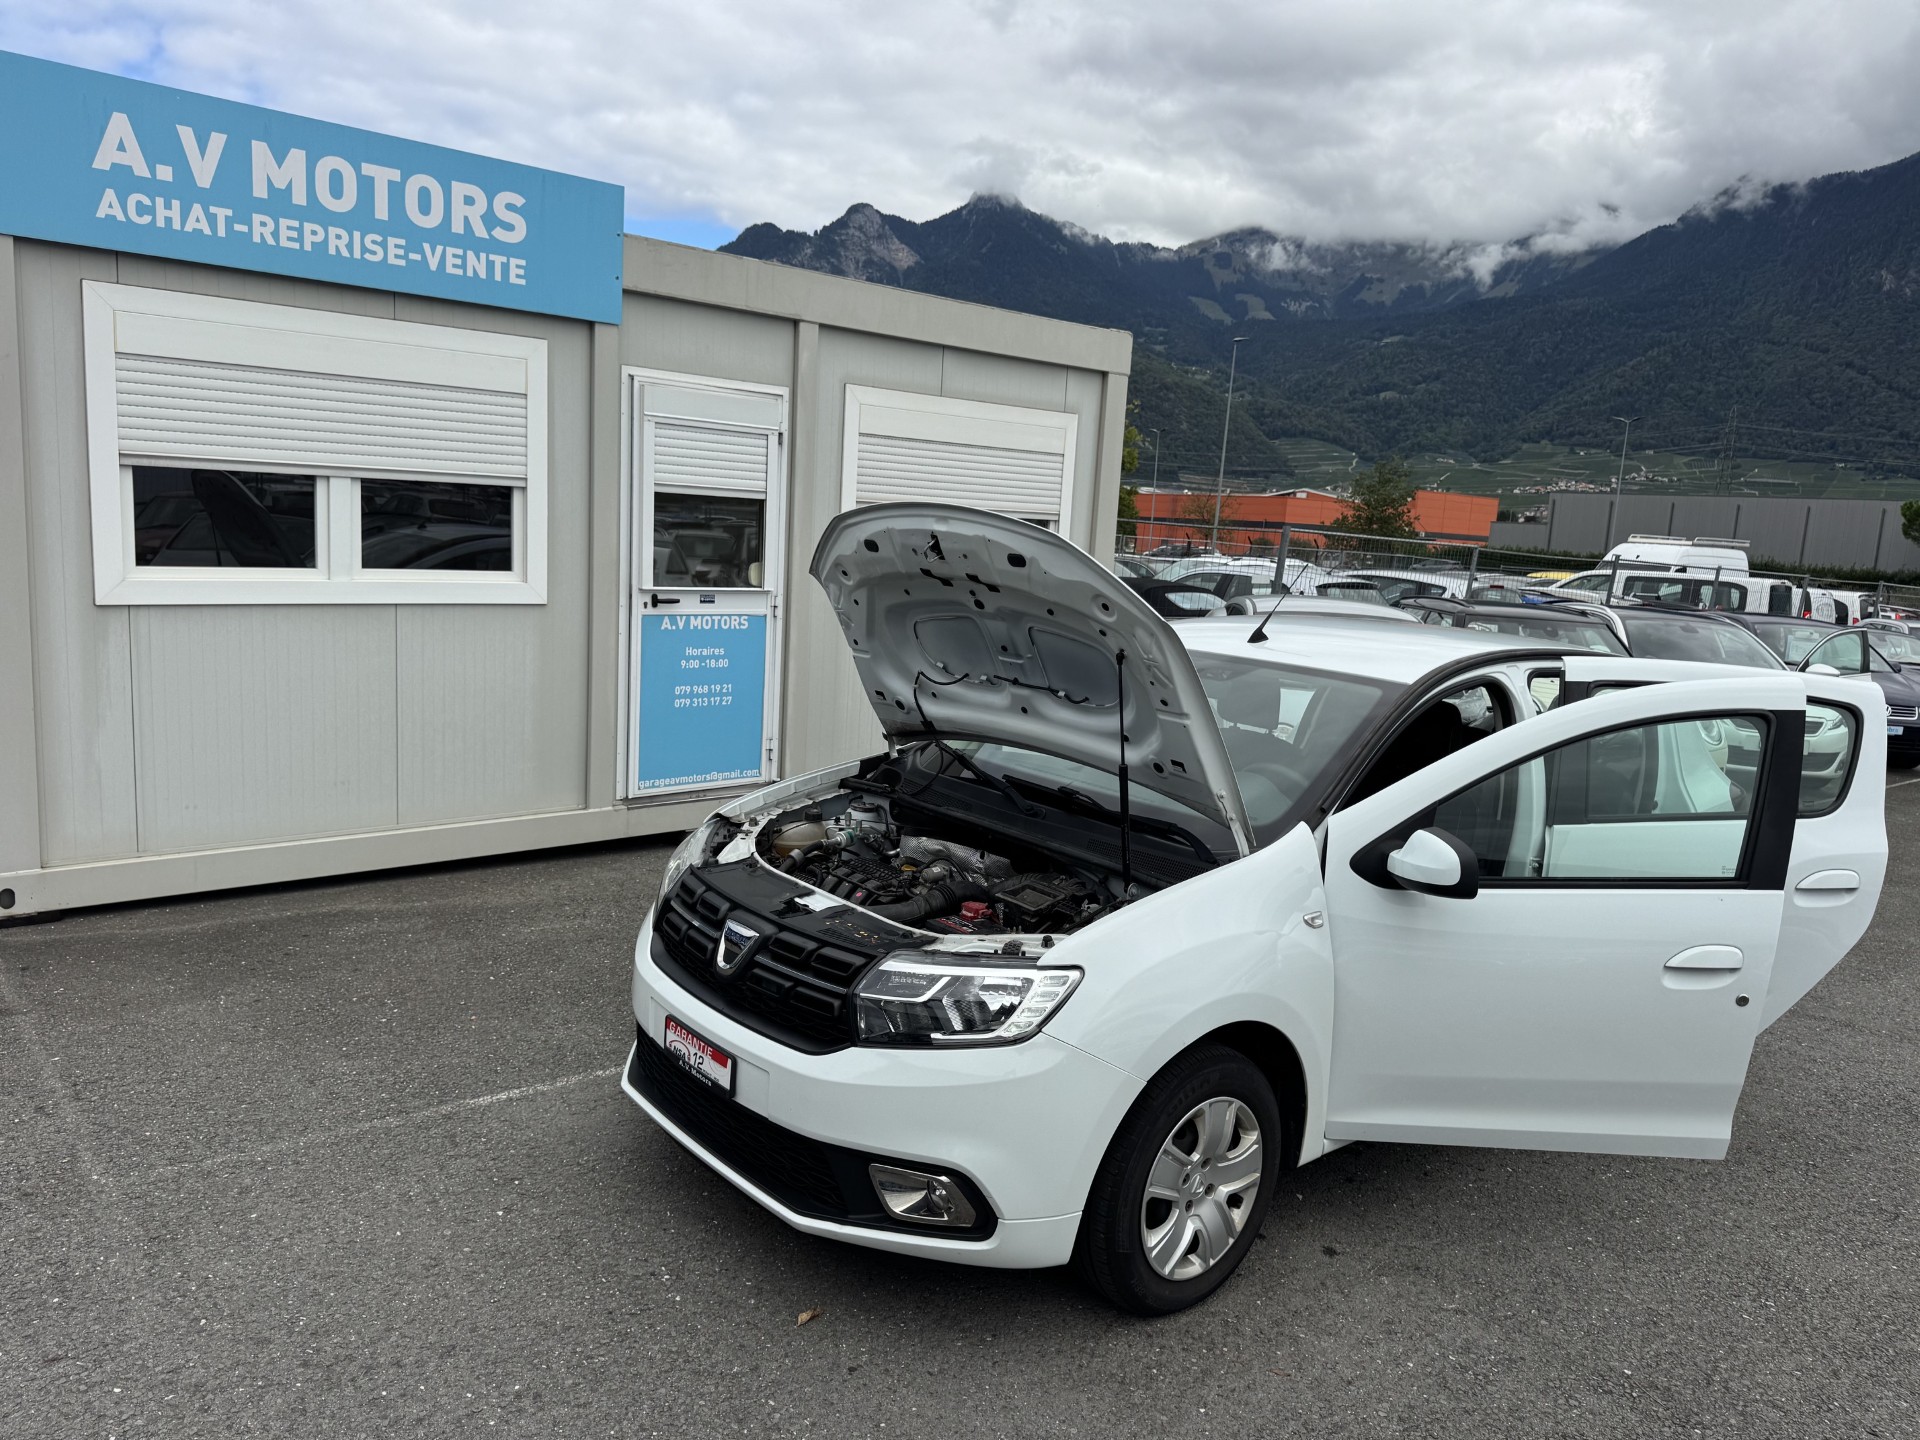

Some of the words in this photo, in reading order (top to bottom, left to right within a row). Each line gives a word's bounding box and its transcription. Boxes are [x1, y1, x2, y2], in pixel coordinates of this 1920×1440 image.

[92, 111, 228, 189] A.V
[251, 139, 528, 244] MOTORS
[95, 188, 527, 286] ACHAT-REPRISE-VENTE
[660, 615, 686, 630] A.V
[690, 615, 749, 630] MOTORS
[685, 646, 725, 656] Horaires
[680, 659, 700, 669] 9:00
[674, 685, 691, 695] 079
[692, 684, 709, 694] 968
[710, 684, 721, 693] 19
[722, 683, 732, 693] 21
[674, 698, 691, 708] 079
[692, 697, 708, 707] 313
[710, 696, 721, 706] 17
[721, 696, 732, 705] 27
[638, 768, 761, 790] garageavmotors@gmail.com
[669, 1021, 713, 1060] GARANTIE
[692, 1051, 705, 1072] 12
[691, 1066, 712, 1087] Motors
